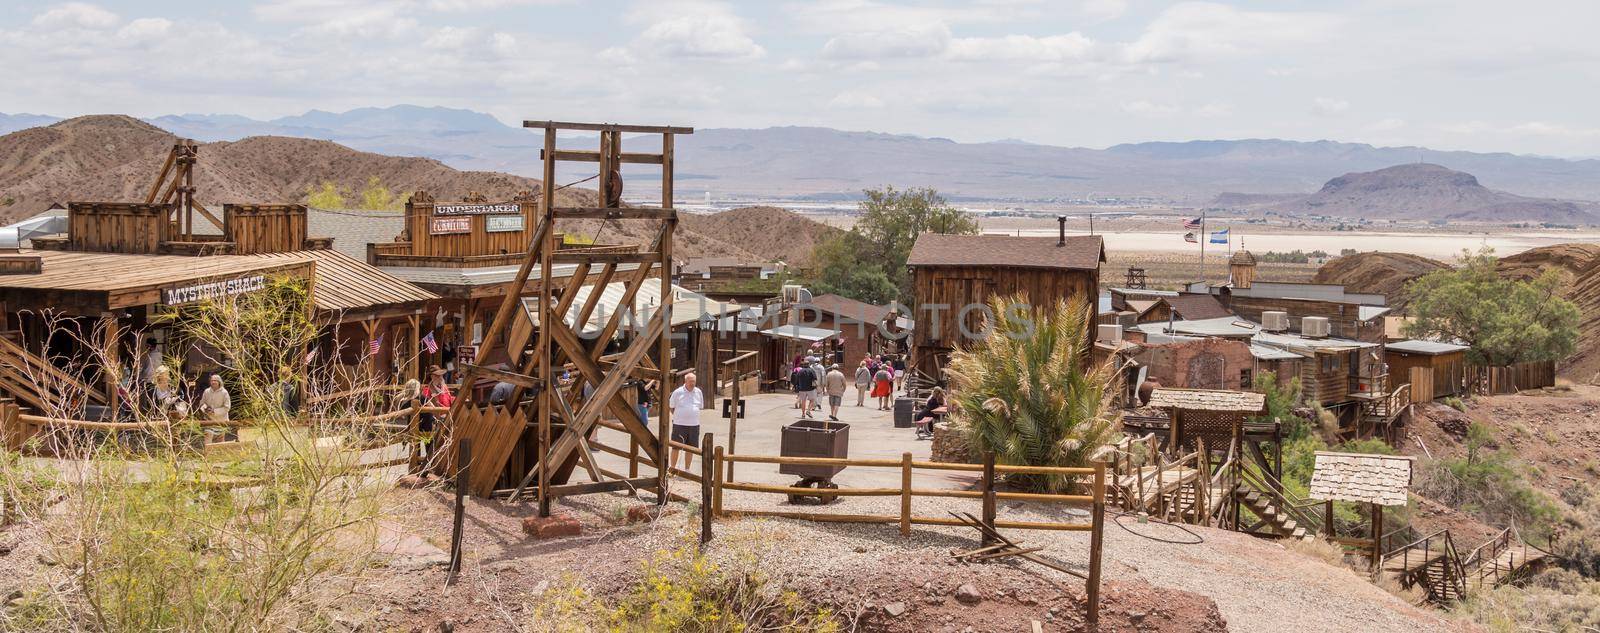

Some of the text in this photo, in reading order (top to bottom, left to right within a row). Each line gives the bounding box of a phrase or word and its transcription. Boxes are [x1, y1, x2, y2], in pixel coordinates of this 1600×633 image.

[437, 204, 519, 213] UNDERTAKER
[168, 275, 265, 305] MYSTERY SHACK
